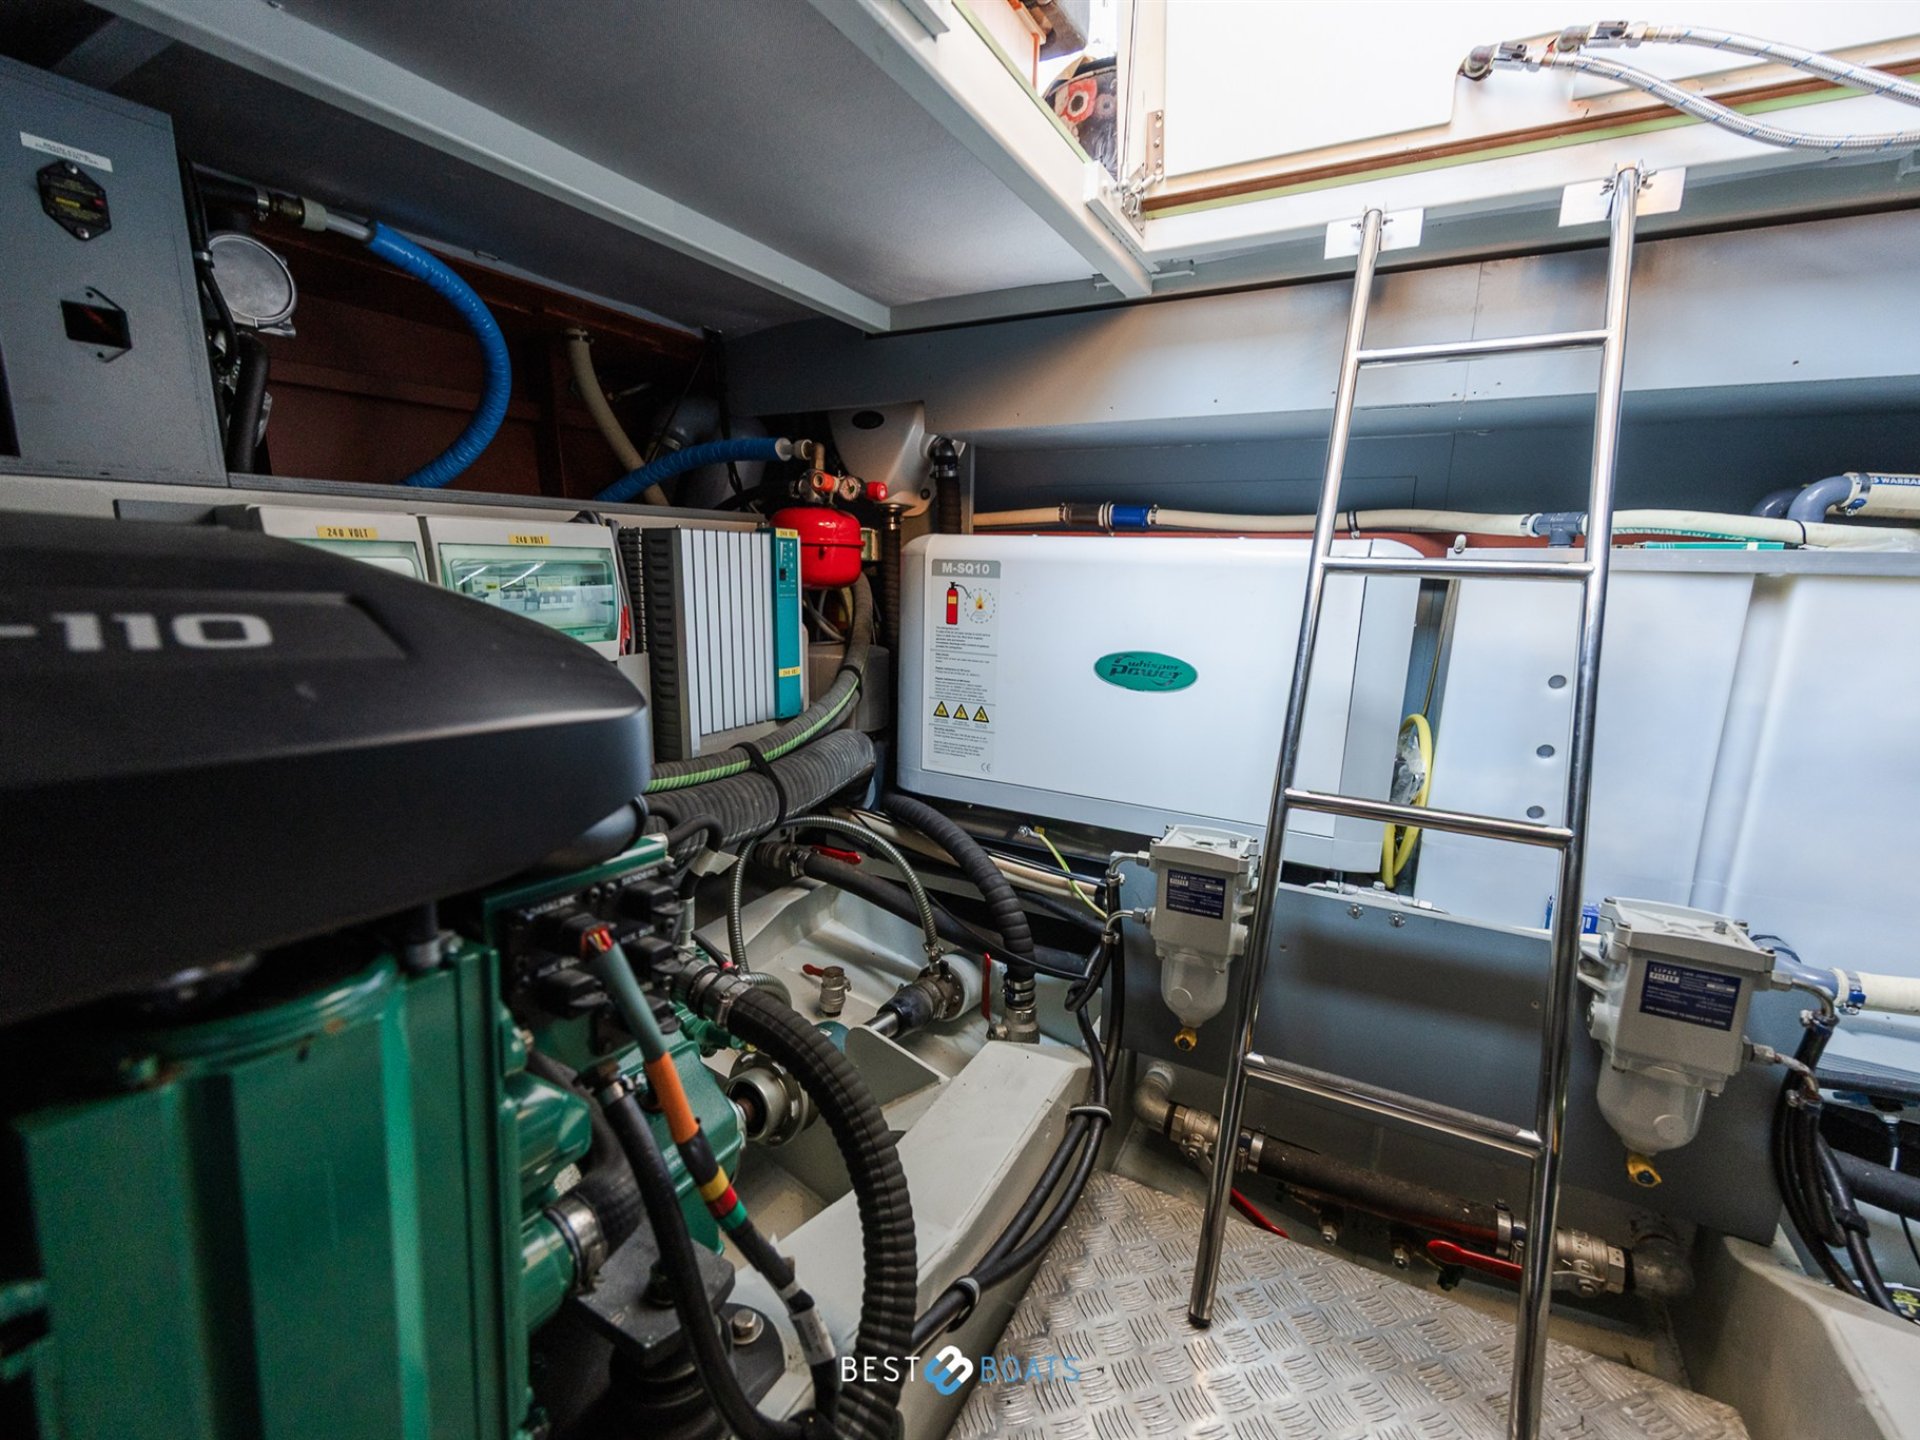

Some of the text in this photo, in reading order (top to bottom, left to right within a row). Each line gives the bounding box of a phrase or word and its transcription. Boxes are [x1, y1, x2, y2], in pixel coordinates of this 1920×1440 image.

[1880, 477, 1920, 486] WARRA
[348, 527, 369, 539] VOLT
[941, 561, 991, 575] M-SQ10
